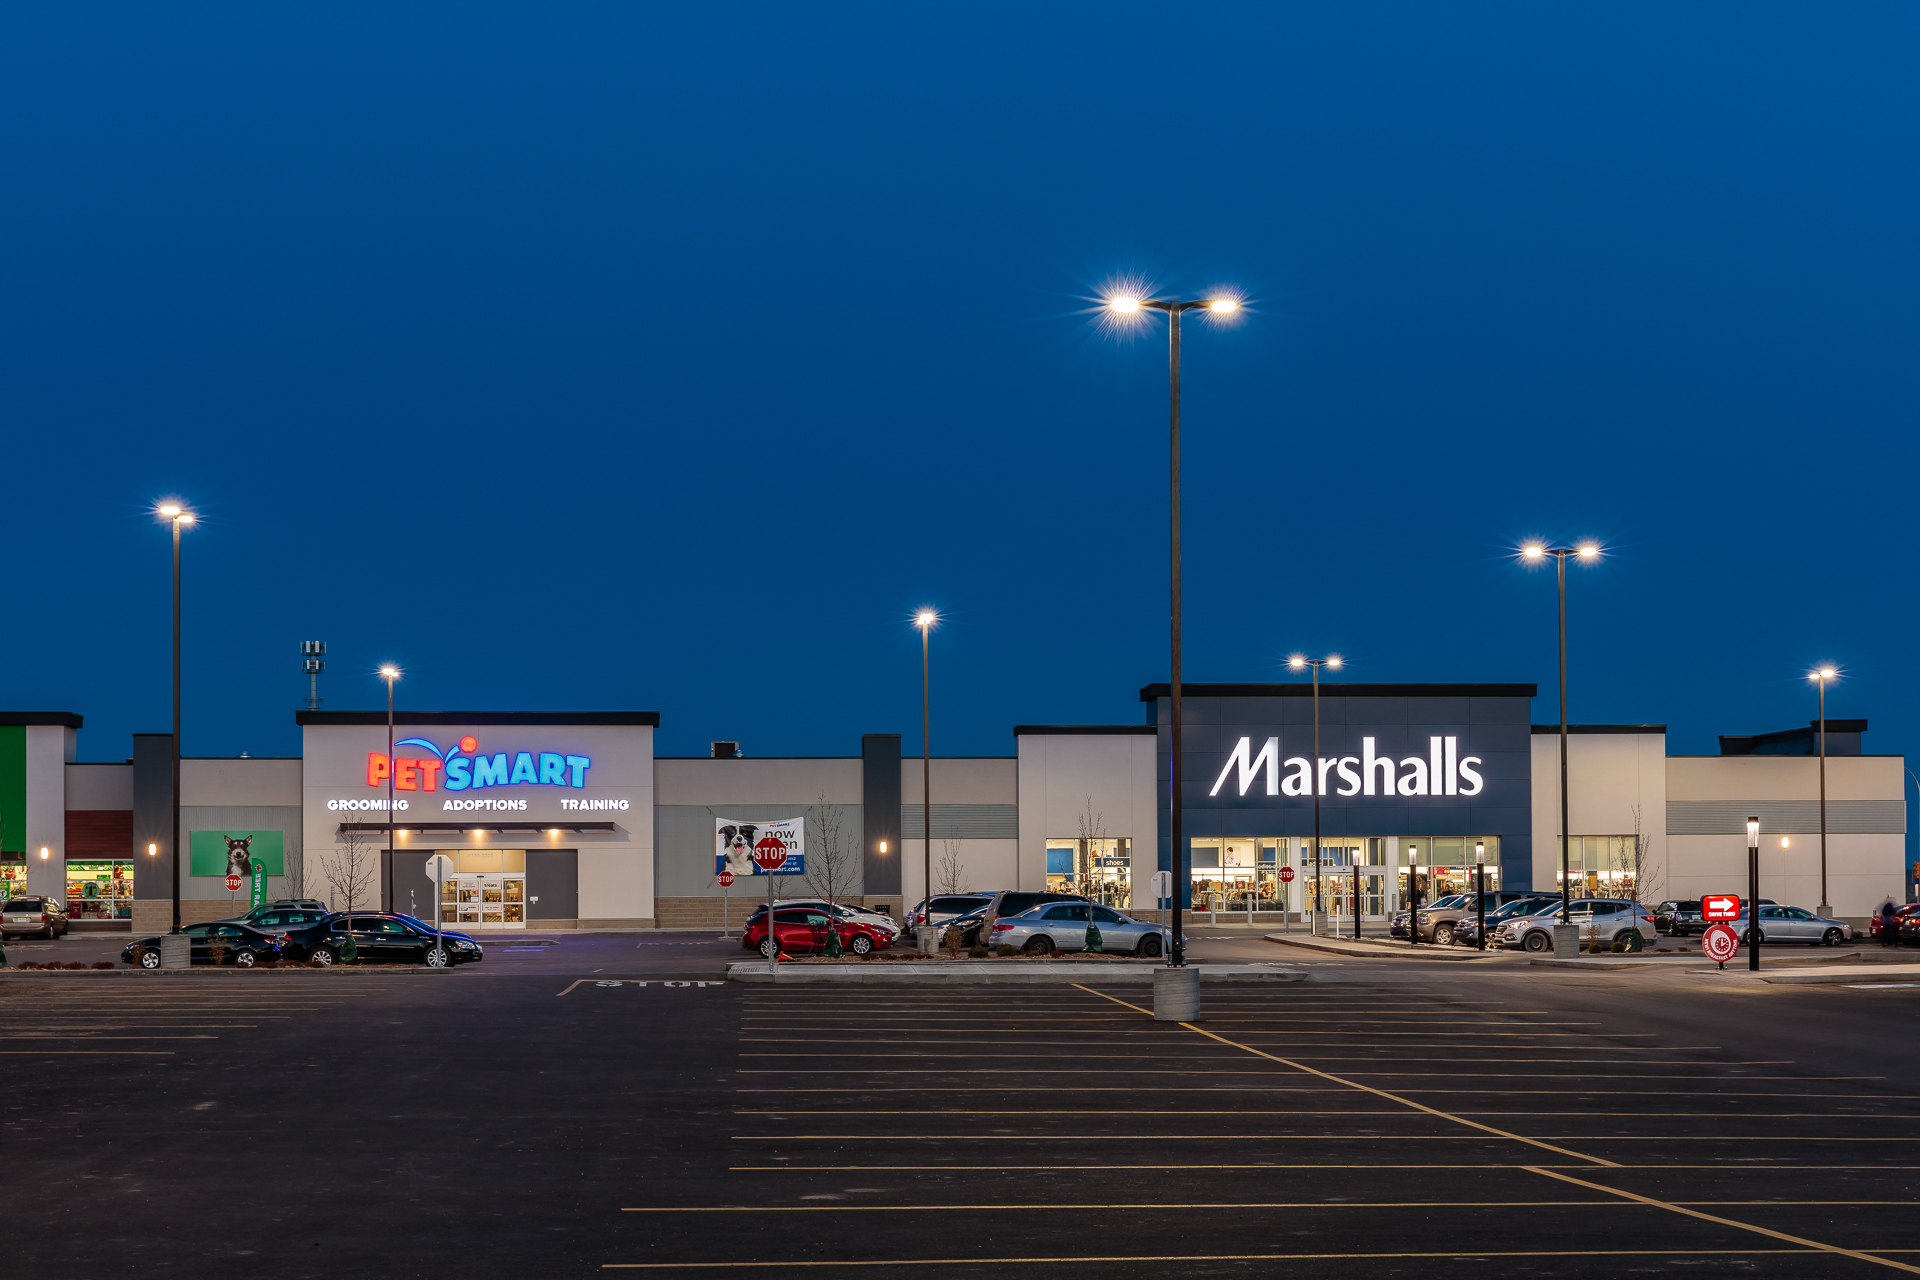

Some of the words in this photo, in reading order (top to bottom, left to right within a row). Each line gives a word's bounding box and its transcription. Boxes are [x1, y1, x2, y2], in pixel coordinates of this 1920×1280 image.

[367, 751, 590, 792] PETSMART
[1209, 736, 1484, 796] Marshalls
[327, 799, 410, 811] GROOMING
[443, 799, 528, 811] ADOPTIONS
[560, 799, 630, 811] TRAINING
[765, 830, 795, 839] now
[782, 840, 798, 849] en
[755, 847, 786, 860] STOP
